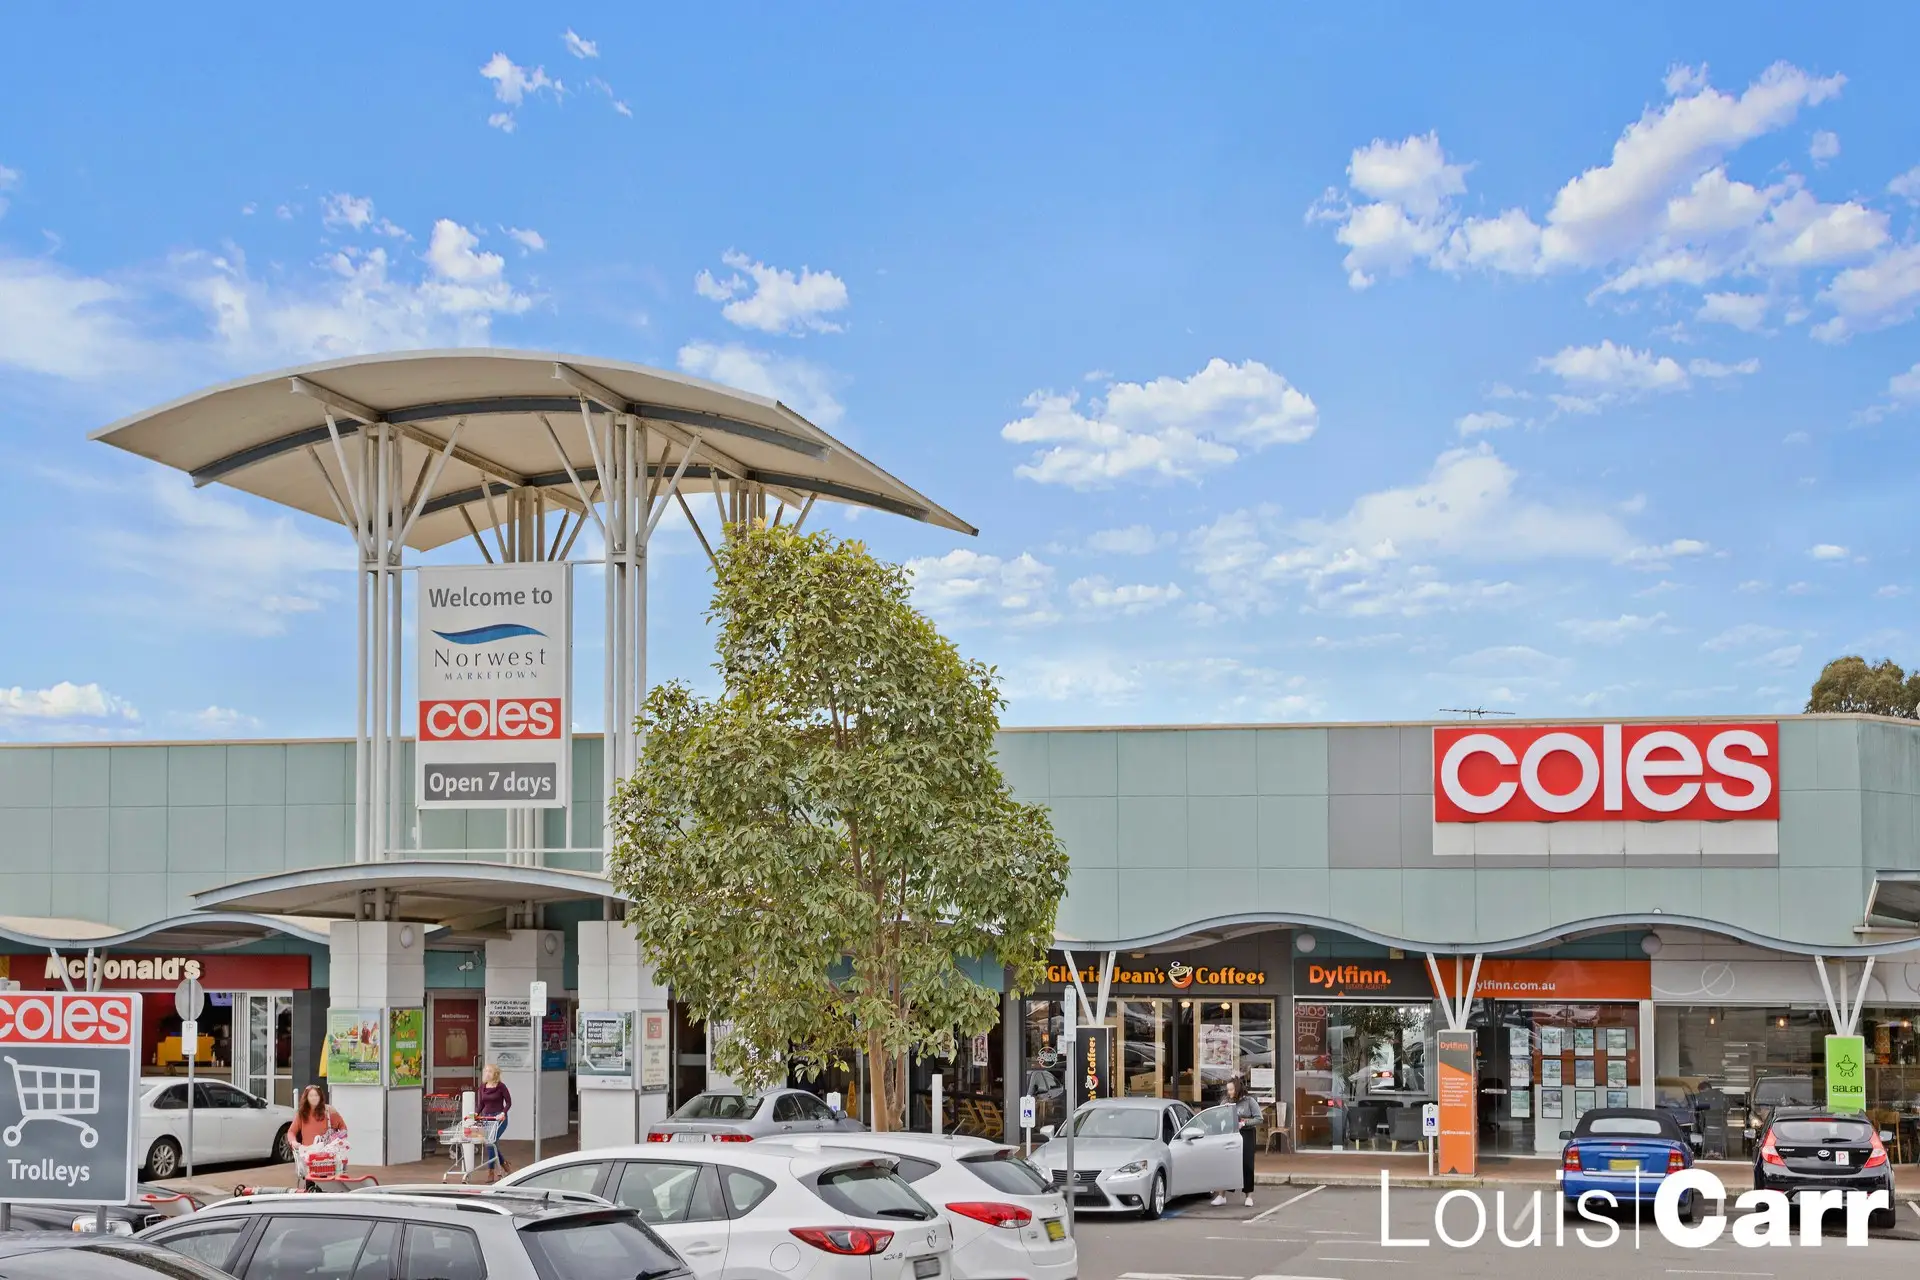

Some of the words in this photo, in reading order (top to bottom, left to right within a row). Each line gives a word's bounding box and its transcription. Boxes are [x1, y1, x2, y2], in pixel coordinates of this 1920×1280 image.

[429, 587, 525, 608] Welcome
[532, 587, 553, 604] to
[434, 648, 546, 667] Norwest
[444, 671, 538, 680] MARKETOWN
[427, 700, 553, 738] coles
[1441, 724, 1772, 813] coles
[429, 772, 483, 798] Open
[488, 771, 500, 791] 7
[503, 770, 551, 797] days
[1112, 966, 1165, 984] Jean's
[1195, 967, 1265, 984] Coffees
[1476, 980, 1556, 992] ylfinn.com.au
[1086, 1036, 1097, 1075] Coffees
[1838, 1153, 1846, 1163] P
[7, 1158, 90, 1187] Trolleys
